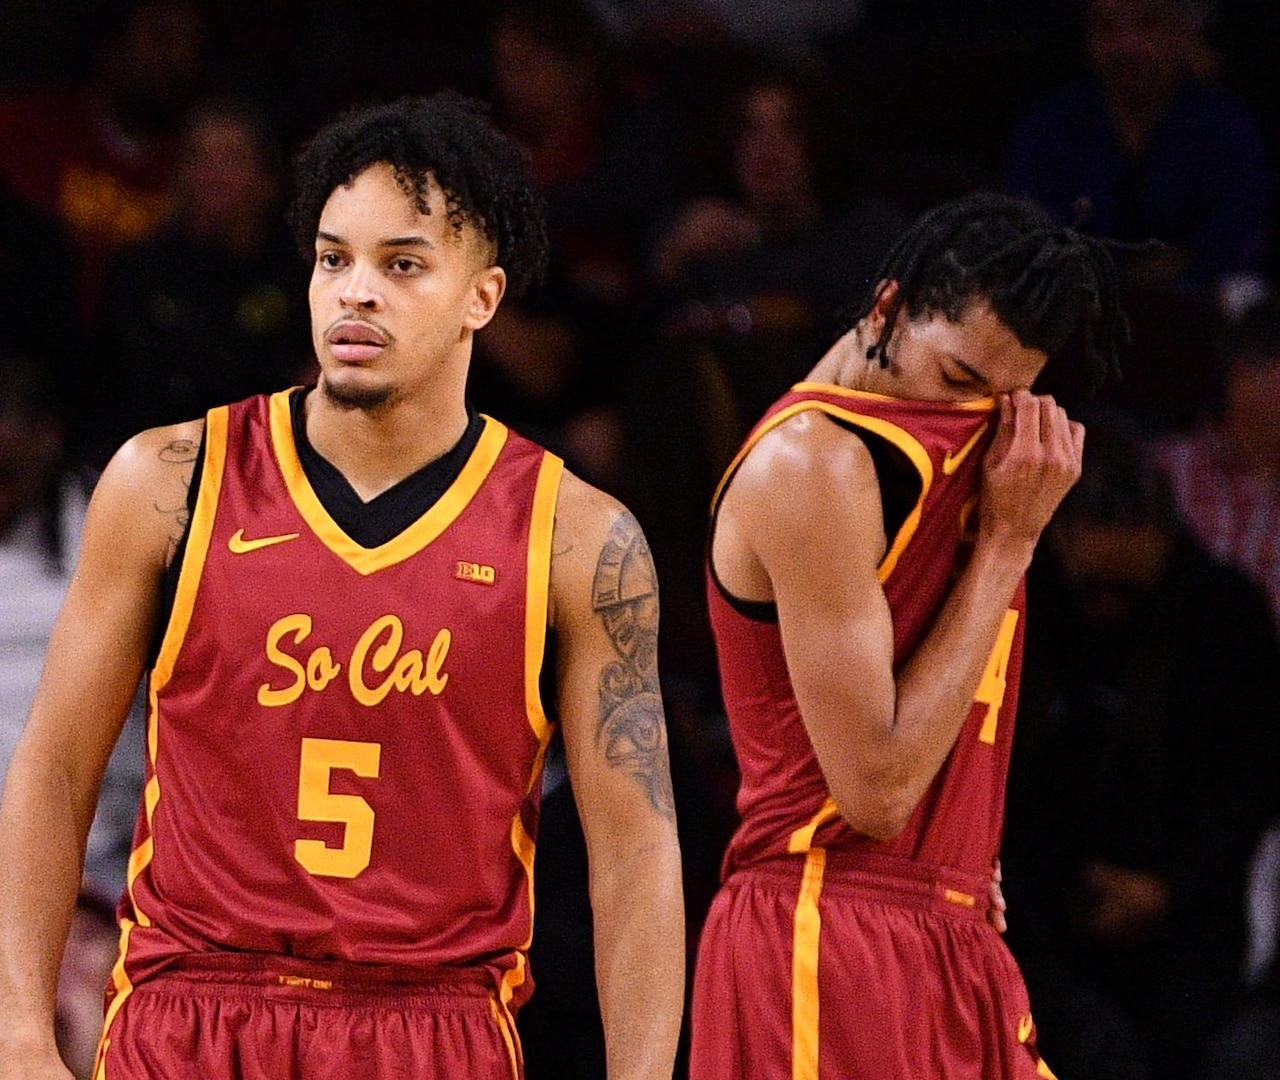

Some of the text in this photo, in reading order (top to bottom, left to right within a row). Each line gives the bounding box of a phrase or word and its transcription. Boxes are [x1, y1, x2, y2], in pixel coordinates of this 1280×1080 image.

[257, 613, 452, 707] So Cal
[294, 737, 381, 879] 5
